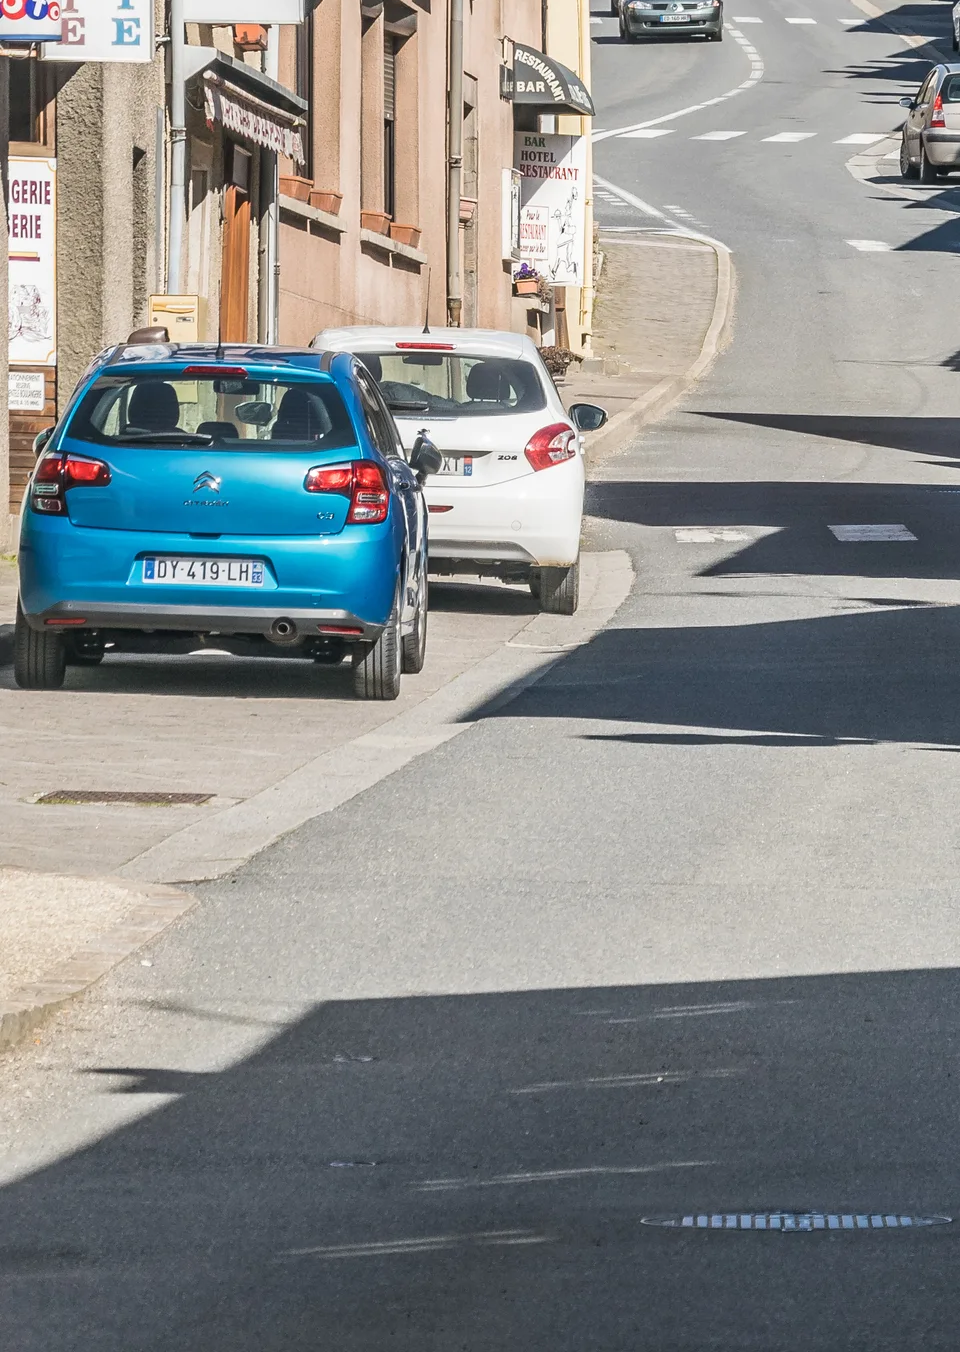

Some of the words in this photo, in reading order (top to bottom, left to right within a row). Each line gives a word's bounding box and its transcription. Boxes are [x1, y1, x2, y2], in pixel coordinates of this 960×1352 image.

[514, 49, 566, 102] RESTAURANT
[516, 81, 546, 93] BAR
[524, 137, 546, 148] BAR
[521, 150, 556, 163] HOTEL
[520, 164, 579, 181] RESTAURANT
[9, 180, 51, 205] GERIE
[442, 458, 460, 472] XT
[465, 465, 472, 474] 12
[157, 559, 249, 582] DY-419-LH
[252, 572, 262, 583] 33
